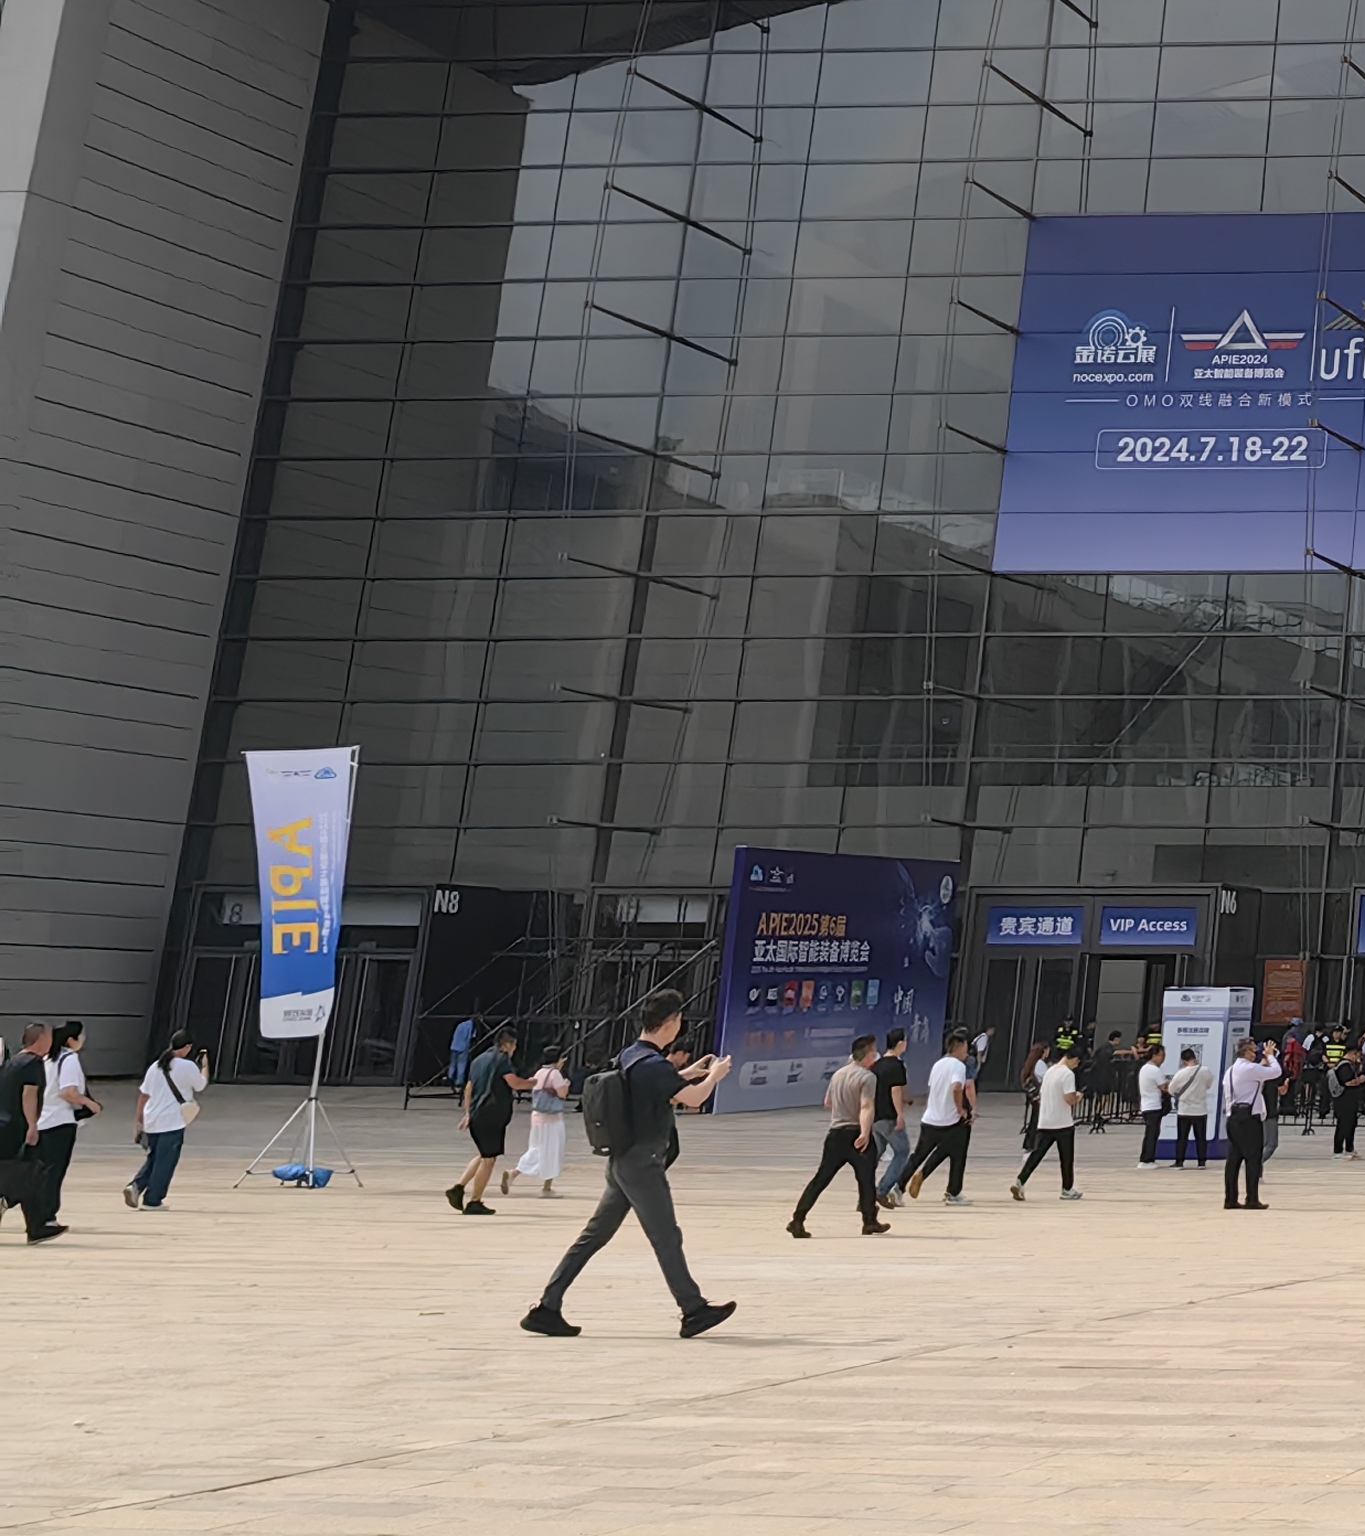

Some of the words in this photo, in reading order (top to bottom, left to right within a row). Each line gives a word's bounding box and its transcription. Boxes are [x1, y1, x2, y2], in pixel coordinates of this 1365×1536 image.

[1074, 346, 1157, 364] 金诺云展
[1212, 353, 1268, 365] APIE2024
[1073, 372, 1154, 384] nocexpo.com
[1117, 436, 1308, 462] 2024.7.18-22
[434, 889, 460, 915] N8
[1220, 890, 1237, 914] N6
[999, 914, 1074, 937] 贵宾通道
[1109, 917, 1136, 932] VIP
[1138, 916, 1187, 933] Access
[752, 939, 872, 963] 亚太国际智能装备博览会
